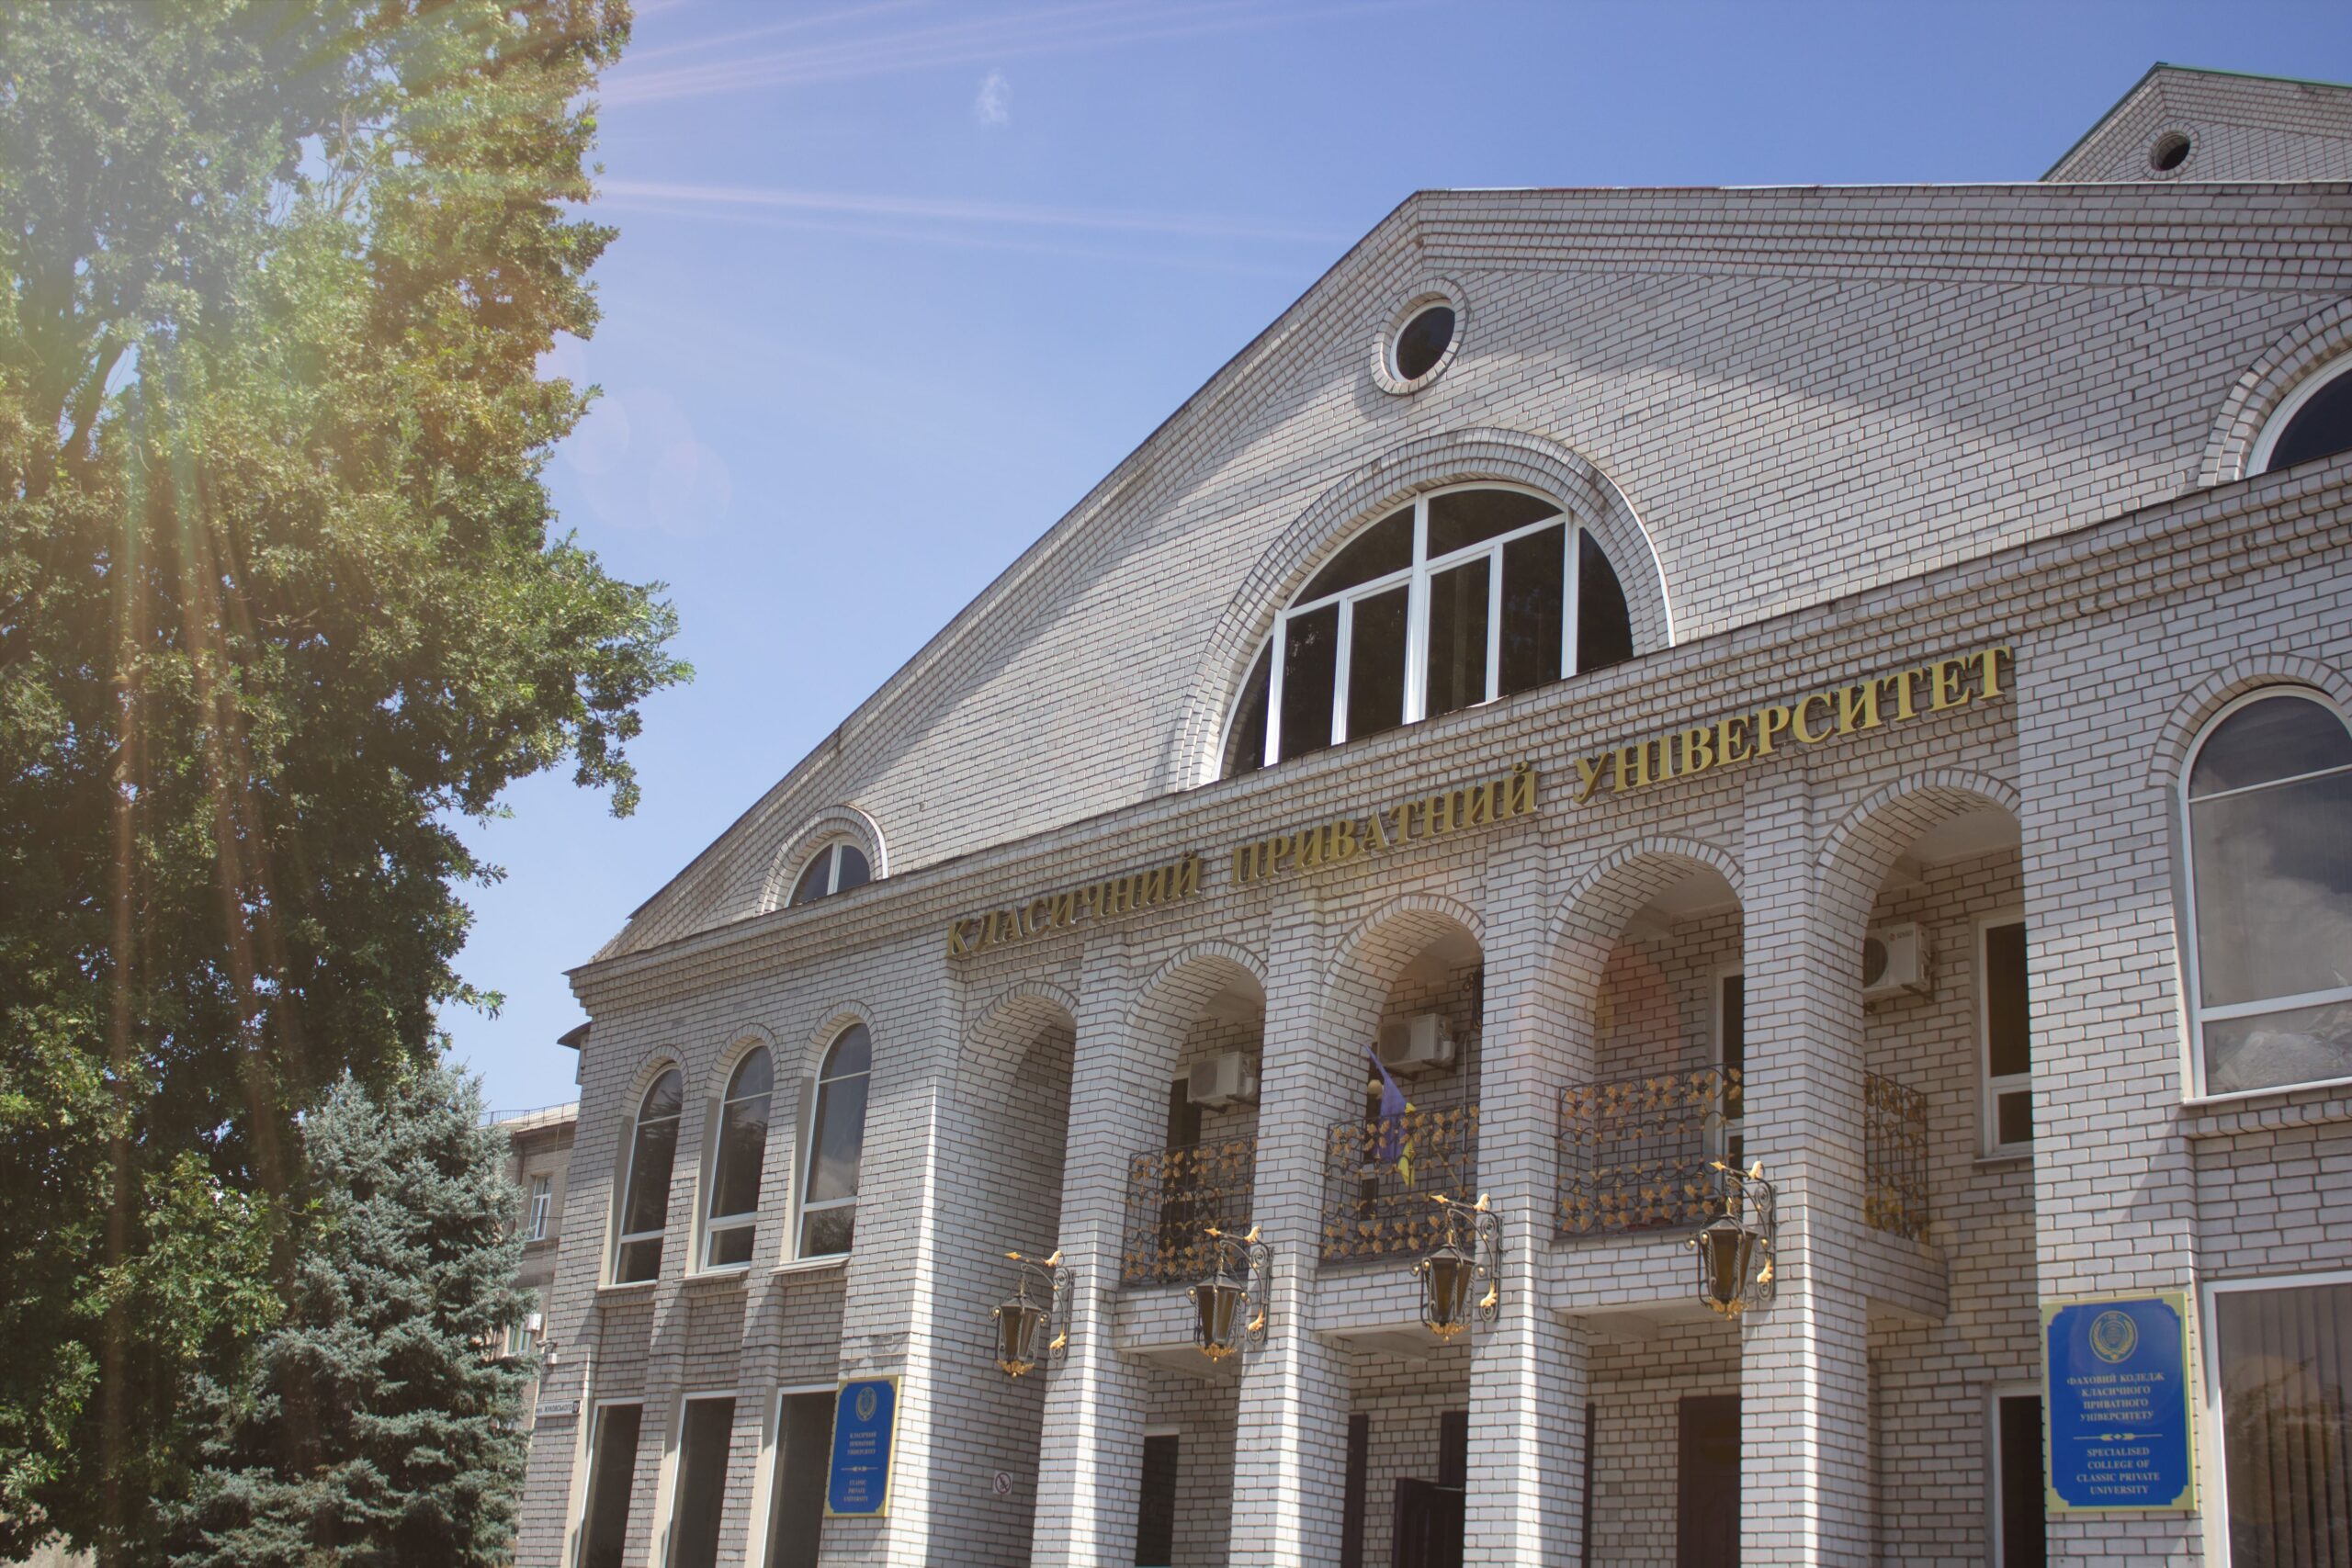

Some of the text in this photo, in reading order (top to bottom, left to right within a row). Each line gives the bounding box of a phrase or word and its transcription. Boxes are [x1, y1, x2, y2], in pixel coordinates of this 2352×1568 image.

[946, 645, 2015, 958] КЛАСИЧНИЙ ПРИВАТНИЙ УНІВЕРСИТЕТ
[2067, 1372, 2165, 1385] ФАХОВИЙ КОЛЕДЖ
[2081, 1385, 2151, 1397] КЛАСИЧНОГО
[2083, 1398, 2149, 1409] ПРИВАТНОГО
[2080, 1410, 2154, 1422] УНІВЕРСИТЕТУ
[2086, 1447, 2150, 1458] SPECIALISED
[2087, 1459, 2150, 1470] COLLEGE OF
[2076, 1472, 2160, 1483] CLASSIC PRIVATE
[2090, 1484, 2149, 1495] UNIVERSITY
